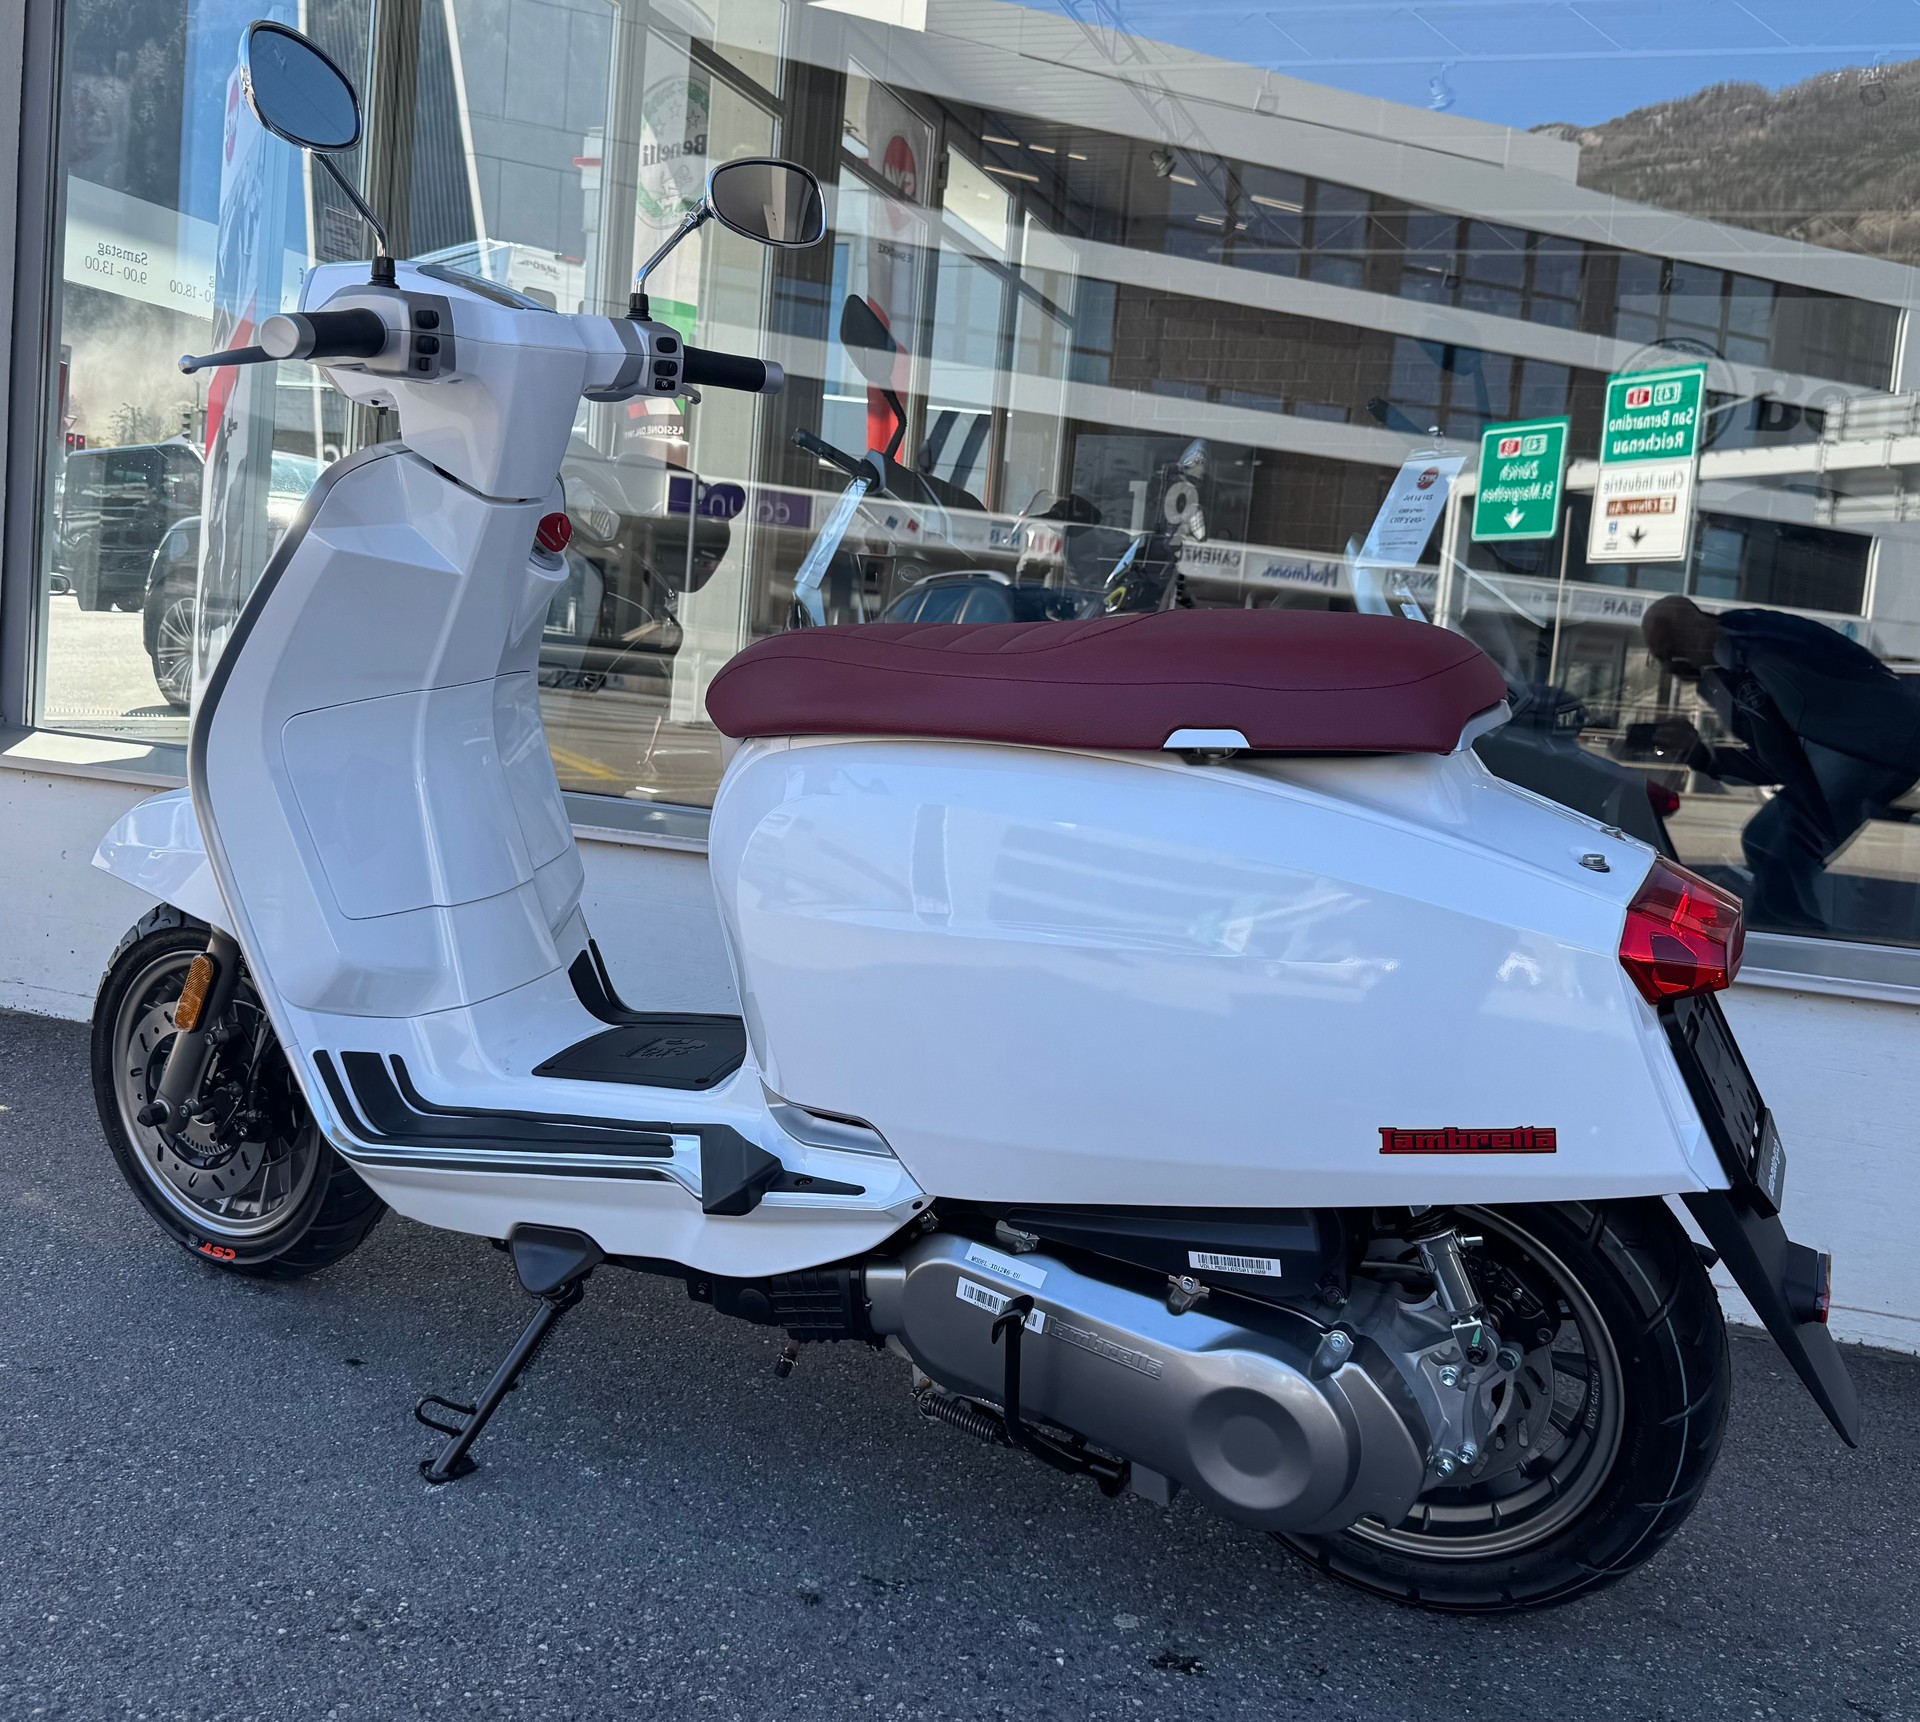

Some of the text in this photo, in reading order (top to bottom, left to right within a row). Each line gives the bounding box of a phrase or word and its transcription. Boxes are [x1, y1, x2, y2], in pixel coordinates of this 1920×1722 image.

[1379, 1126, 1557, 1154] Lambretta
[198, 1242, 236, 1260] CST
[1044, 1314, 1163, 1380] Lambretta
